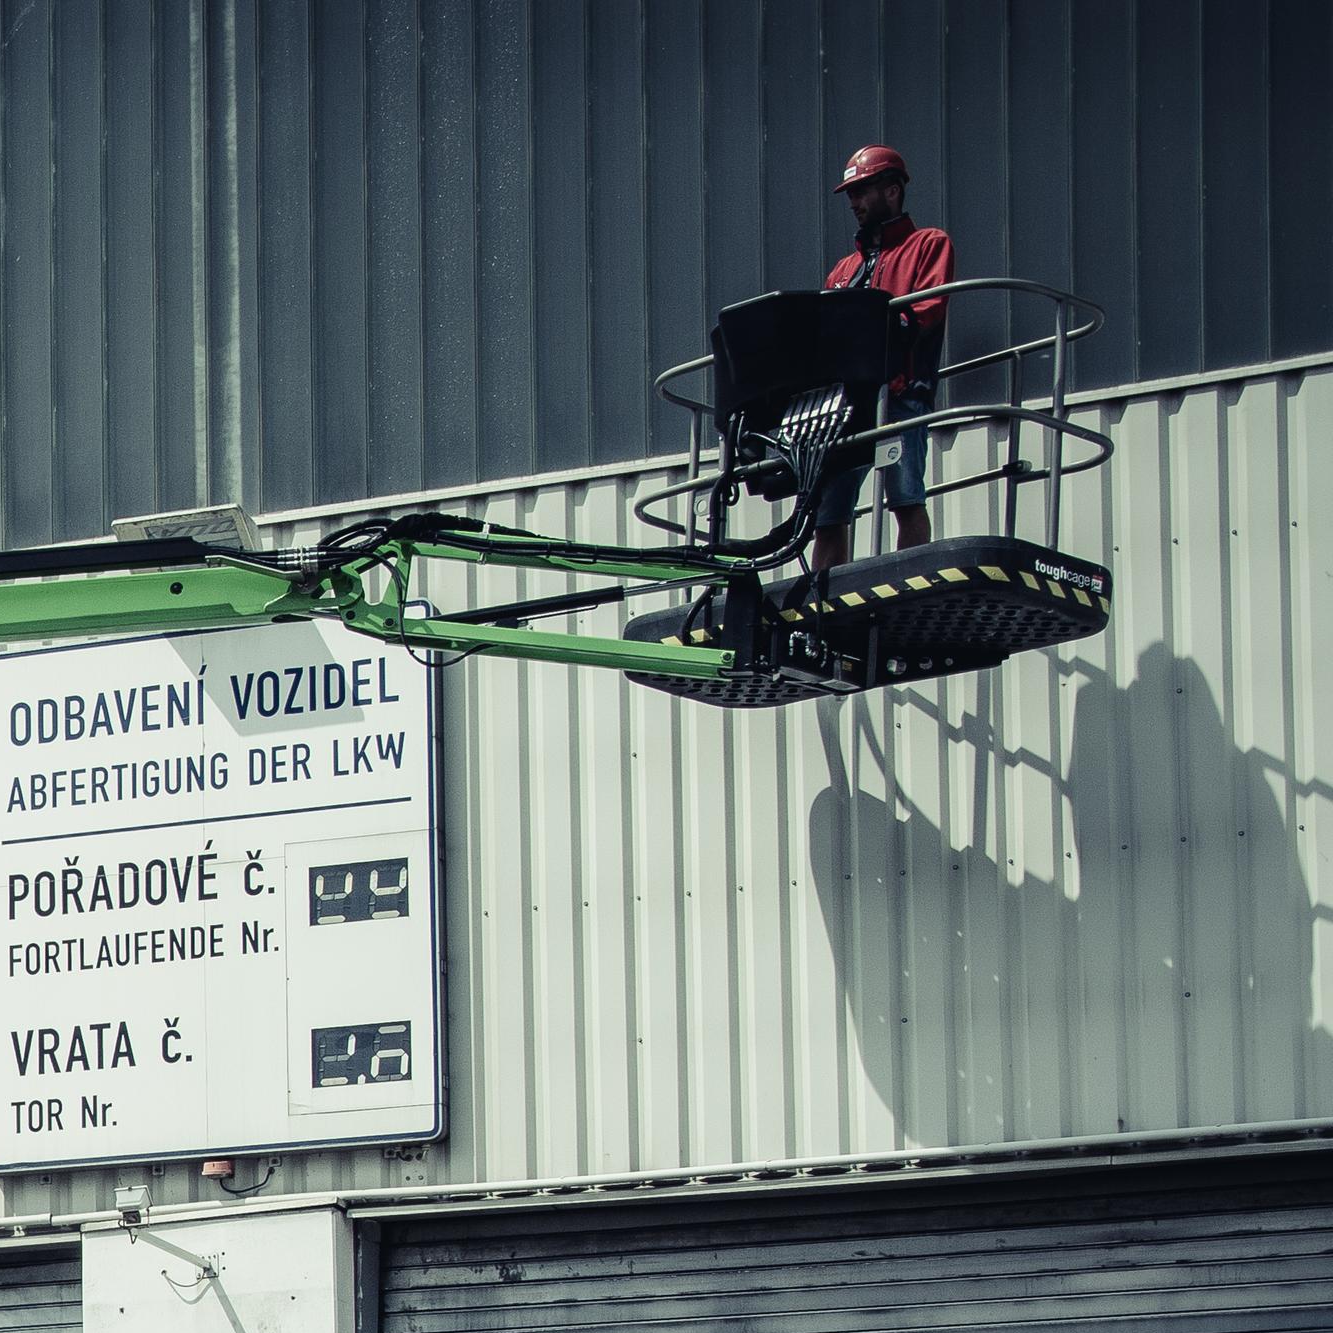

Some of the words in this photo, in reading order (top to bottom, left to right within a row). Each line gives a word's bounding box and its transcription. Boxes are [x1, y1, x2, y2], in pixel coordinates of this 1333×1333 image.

[1035, 559, 1091, 588] toughcage
[9, 665, 206, 747] ODBAVENÍ
[231, 657, 400, 722] VOZIDEL
[7, 752, 230, 814] ABFERTIGUNG
[248, 743, 311, 786] DER
[332, 731, 406, 778] LKW
[8, 839, 219, 920] POŘADOVÉ
[8, 924, 224, 977] FORTLAUFENDE
[241, 920, 280, 955] Nr.
[10, 1021, 137, 1076] VRATA
[11, 1100, 64, 1134] TOR
[80, 1095, 118, 1130] Nr.
